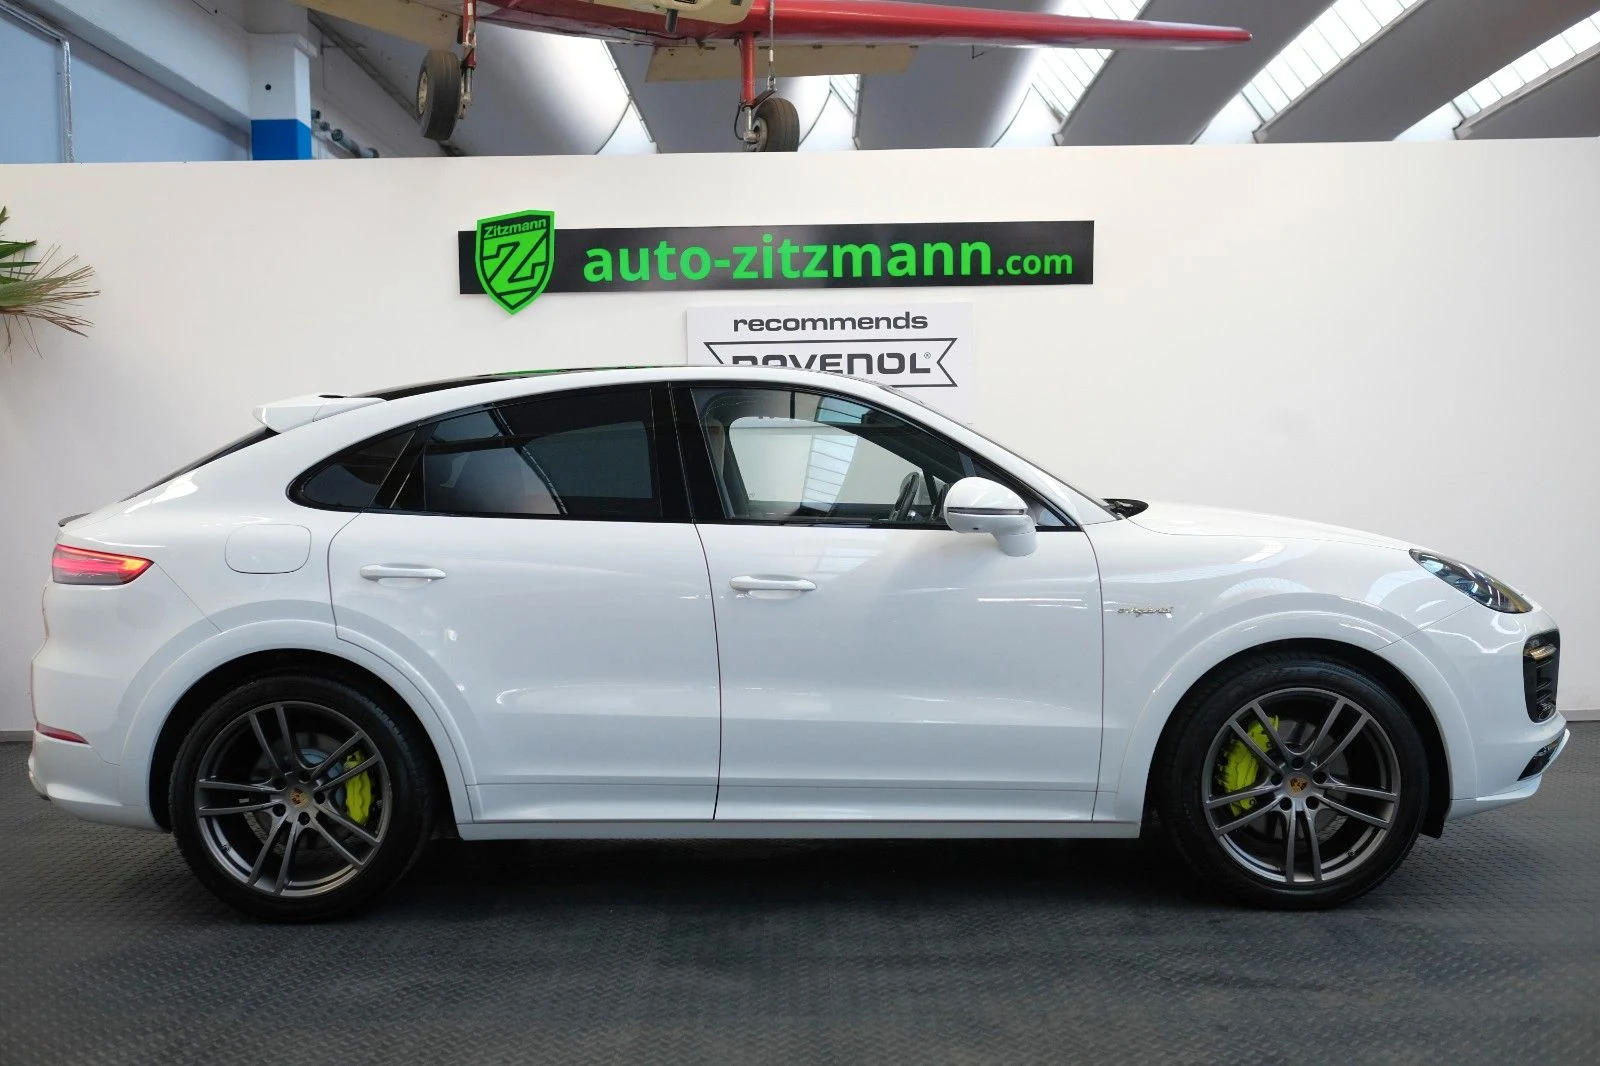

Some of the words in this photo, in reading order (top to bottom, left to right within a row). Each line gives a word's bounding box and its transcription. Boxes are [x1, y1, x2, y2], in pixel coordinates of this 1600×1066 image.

[483, 219, 547, 239] Zitzmann
[583, 233, 1074, 283] auto-zitzmann.com
[733, 311, 928, 332] recommends
